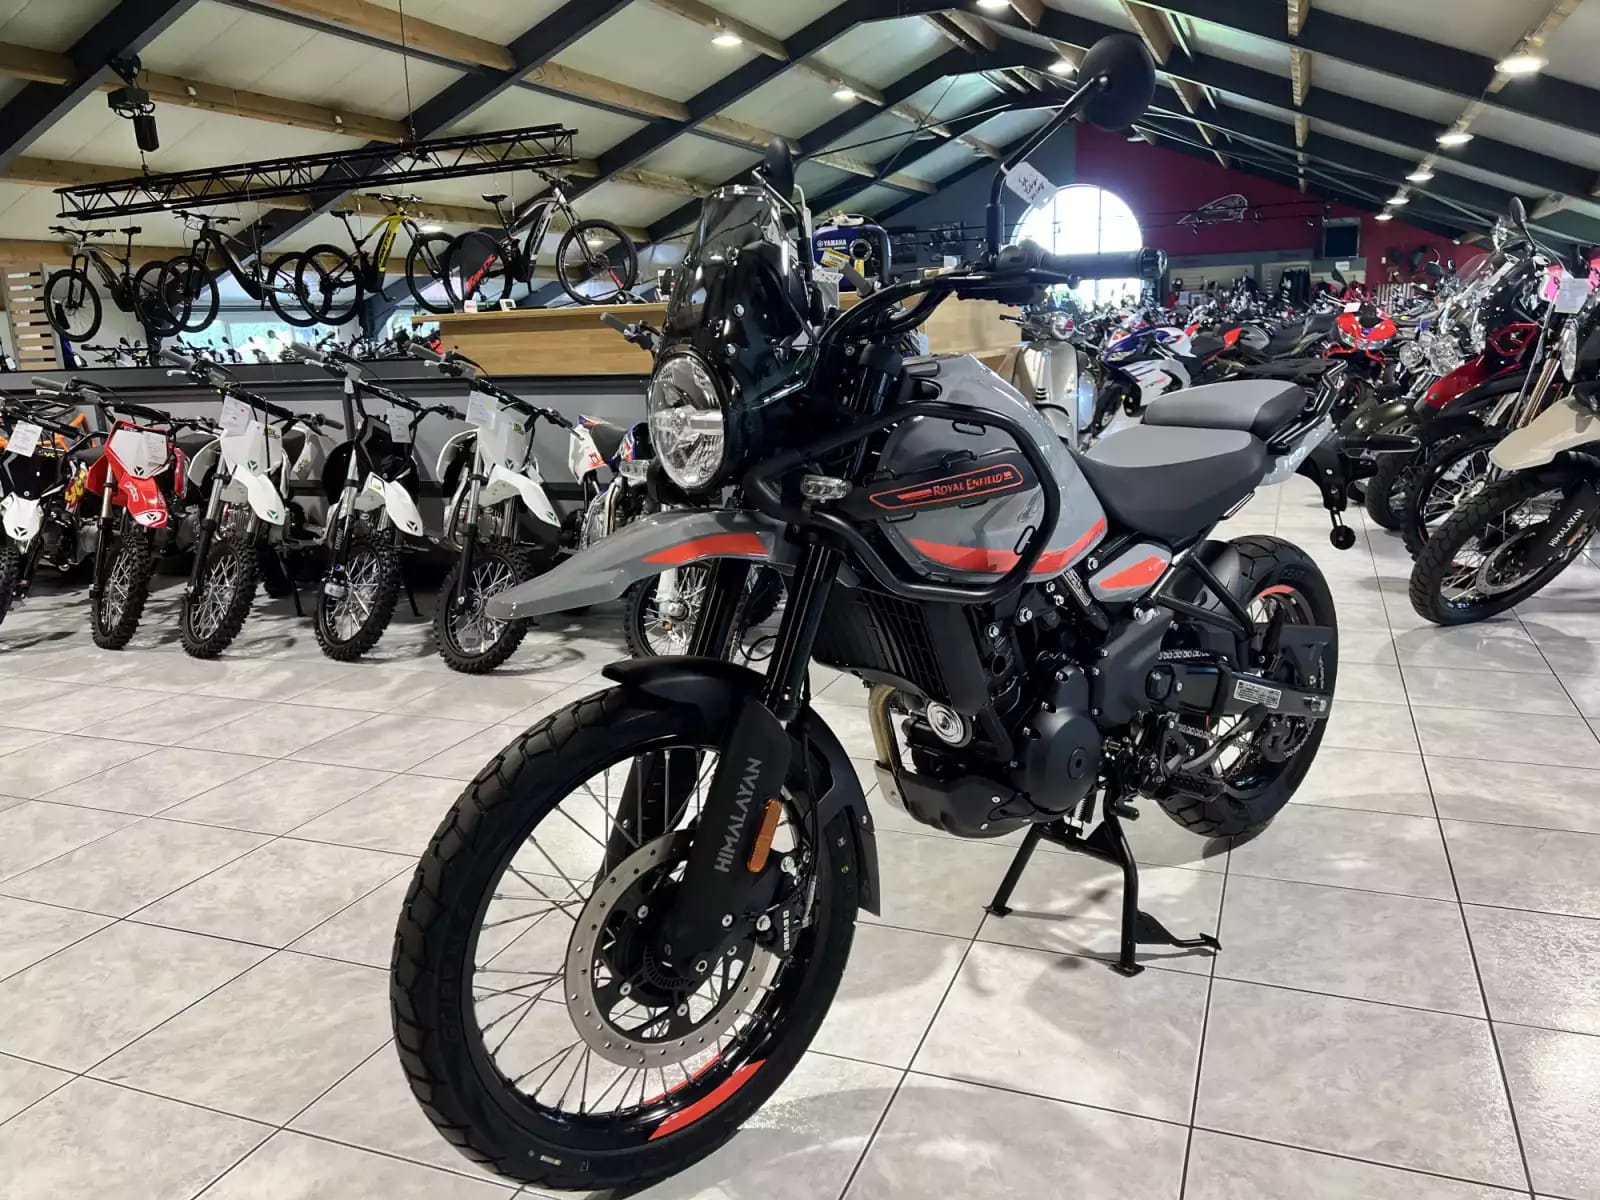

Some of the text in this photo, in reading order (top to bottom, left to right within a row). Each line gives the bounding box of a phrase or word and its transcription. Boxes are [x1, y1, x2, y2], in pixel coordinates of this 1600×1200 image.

[823, 239, 847, 247] YAMAHA
[932, 473, 1002, 497] ROYAL ENFIELD
[1547, 508, 1585, 547] HIMALAYAN
[714, 757, 763, 872] HIMALAYAN
